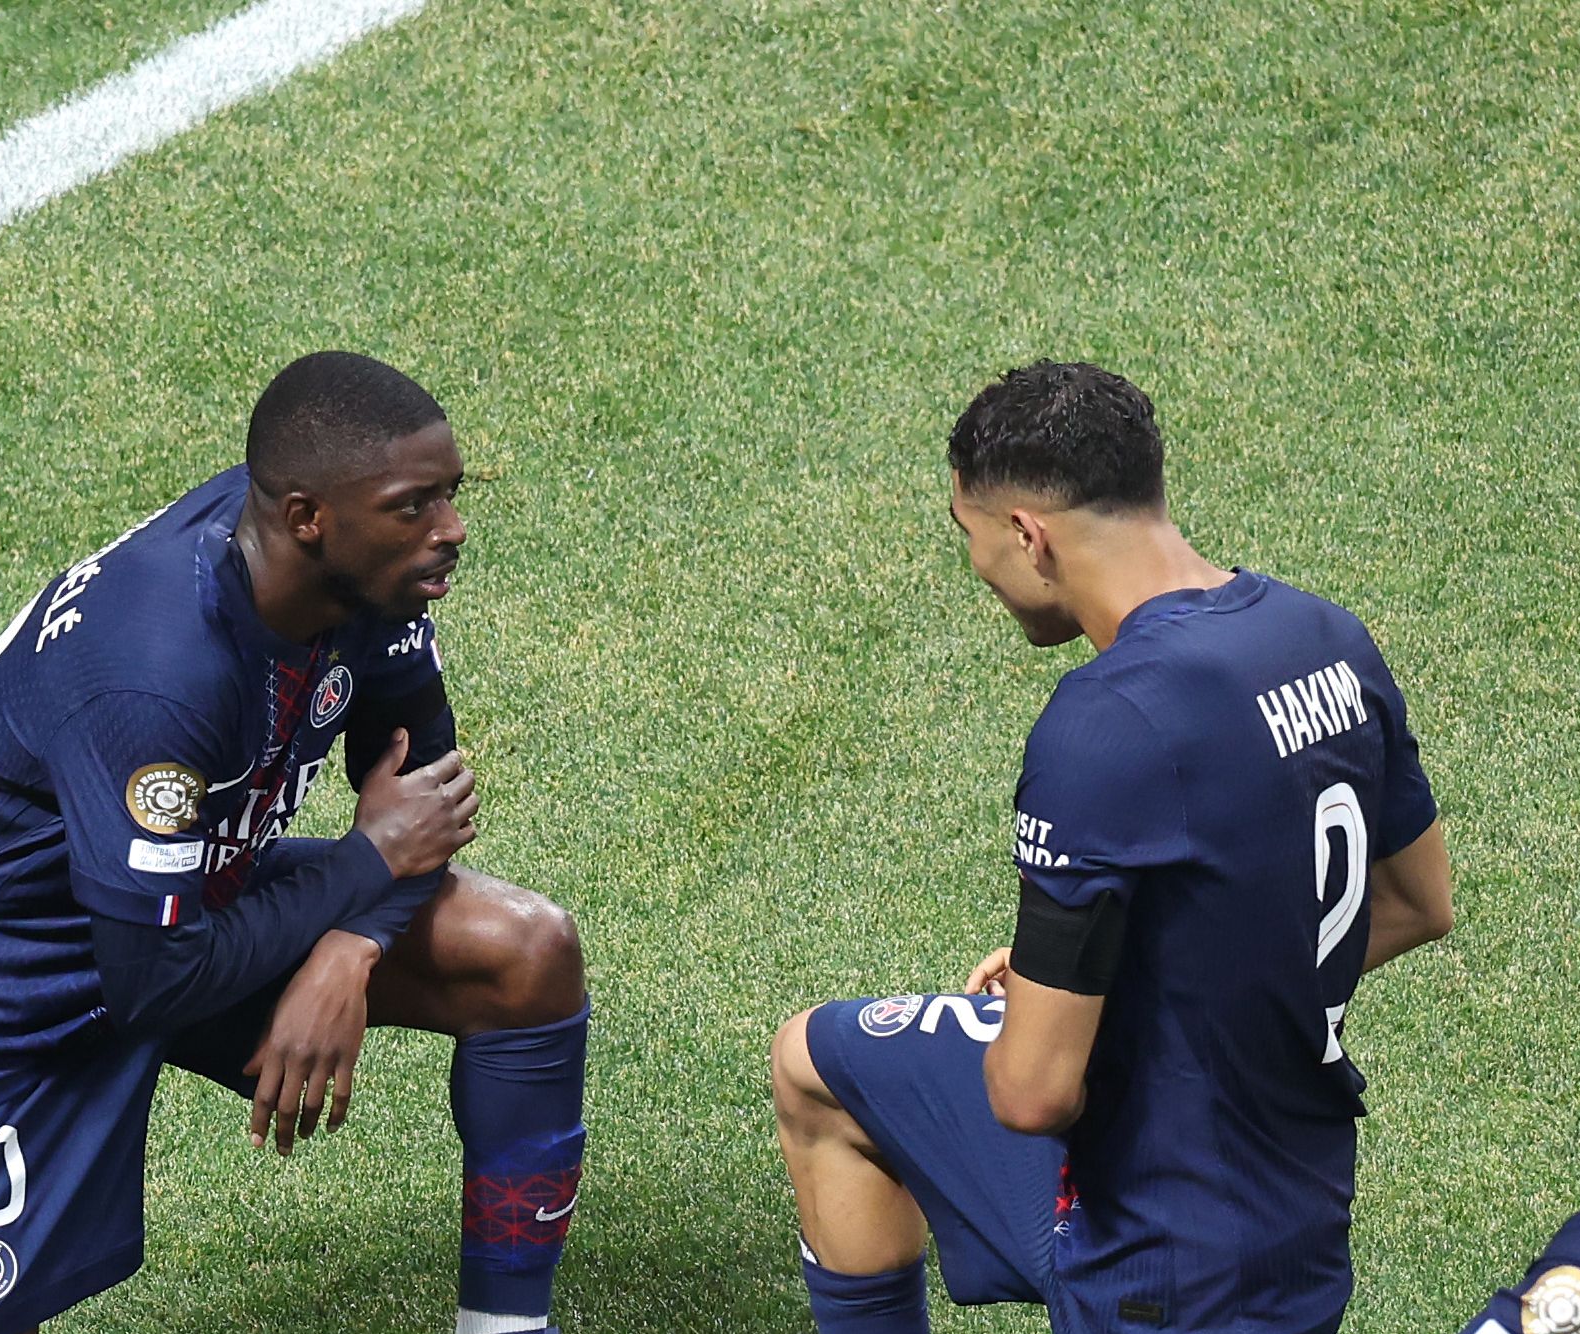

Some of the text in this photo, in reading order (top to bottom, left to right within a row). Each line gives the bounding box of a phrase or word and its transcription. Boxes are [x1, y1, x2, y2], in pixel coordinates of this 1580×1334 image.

[1257, 661, 1367, 758] HAKIMI
[139, 770, 177, 785] WORLD
[146, 812, 178, 827] FIFA
[919, 995, 1006, 1042] 2
